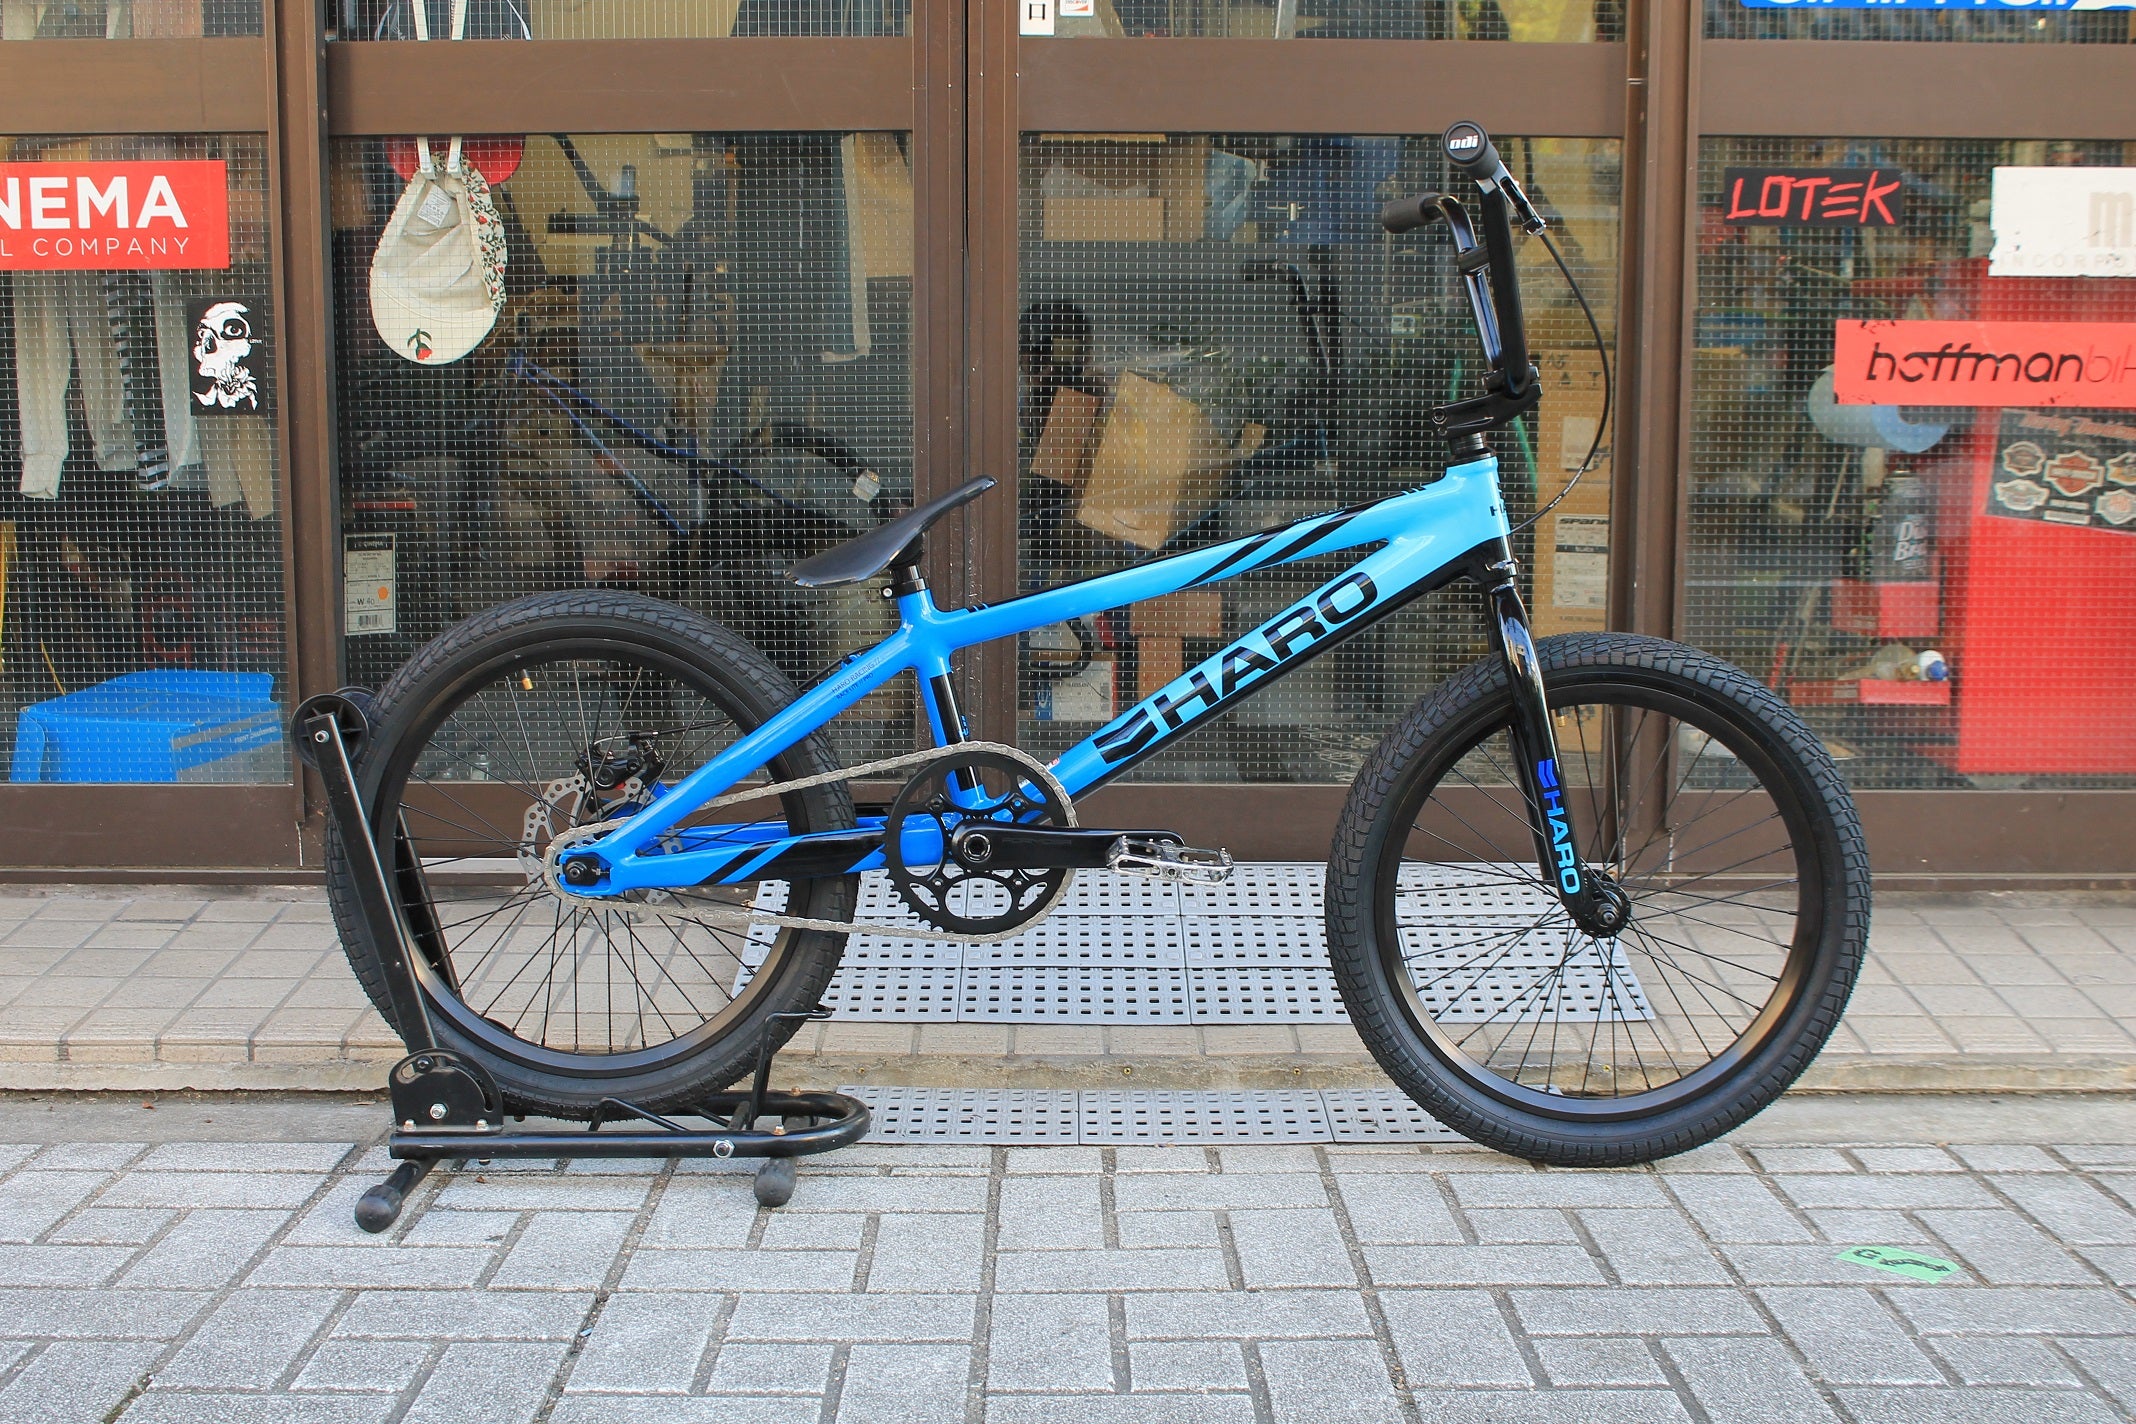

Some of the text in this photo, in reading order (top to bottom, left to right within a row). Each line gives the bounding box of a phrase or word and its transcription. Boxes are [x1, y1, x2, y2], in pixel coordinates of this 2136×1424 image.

[1450, 134, 1479, 150] odi
[1726, 170, 1900, 225] LOTEK
[33, 237, 189, 257] COMPANY
[1153, 572, 1378, 731] HARO
[1543, 790, 1581, 894] HARO
